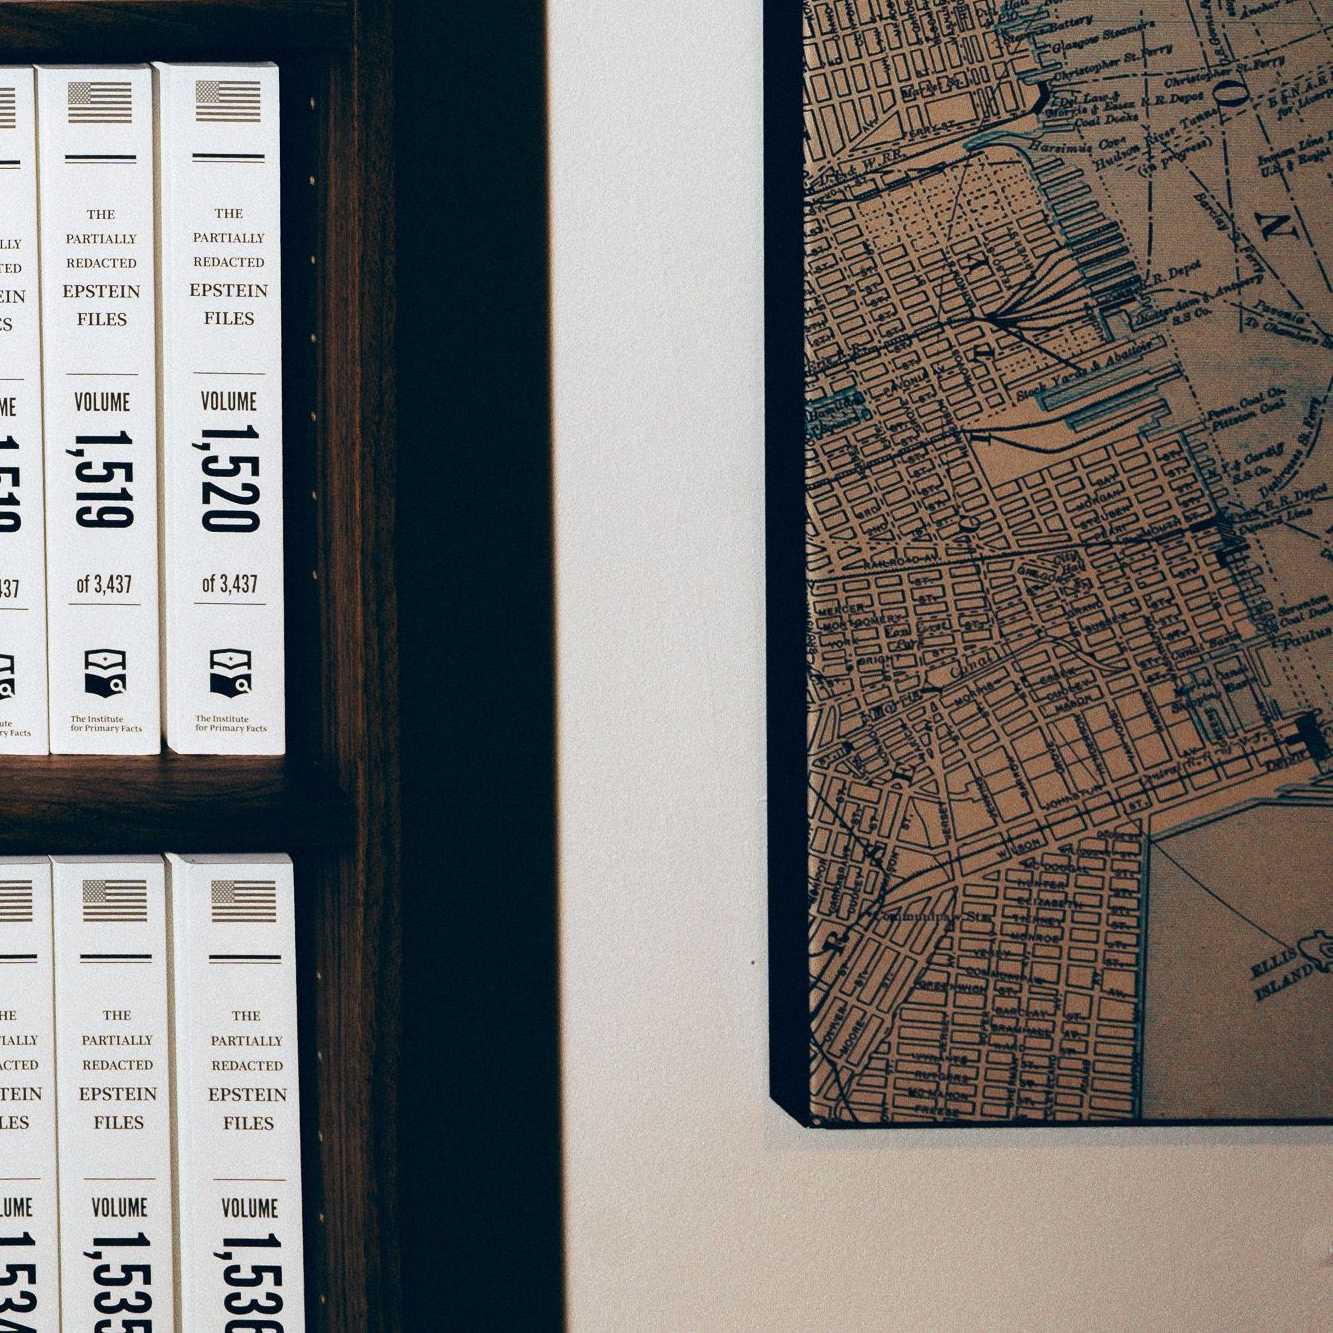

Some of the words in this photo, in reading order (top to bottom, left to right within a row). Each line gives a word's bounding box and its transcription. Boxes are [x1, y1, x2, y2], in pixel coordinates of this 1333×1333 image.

[1164, 68, 1231, 88] Christopher
[191, 424, 261, 533] 1,520
[1250, 946, 1299, 980] ELLIS
[1254, 964, 1315, 1003] ISLAND
